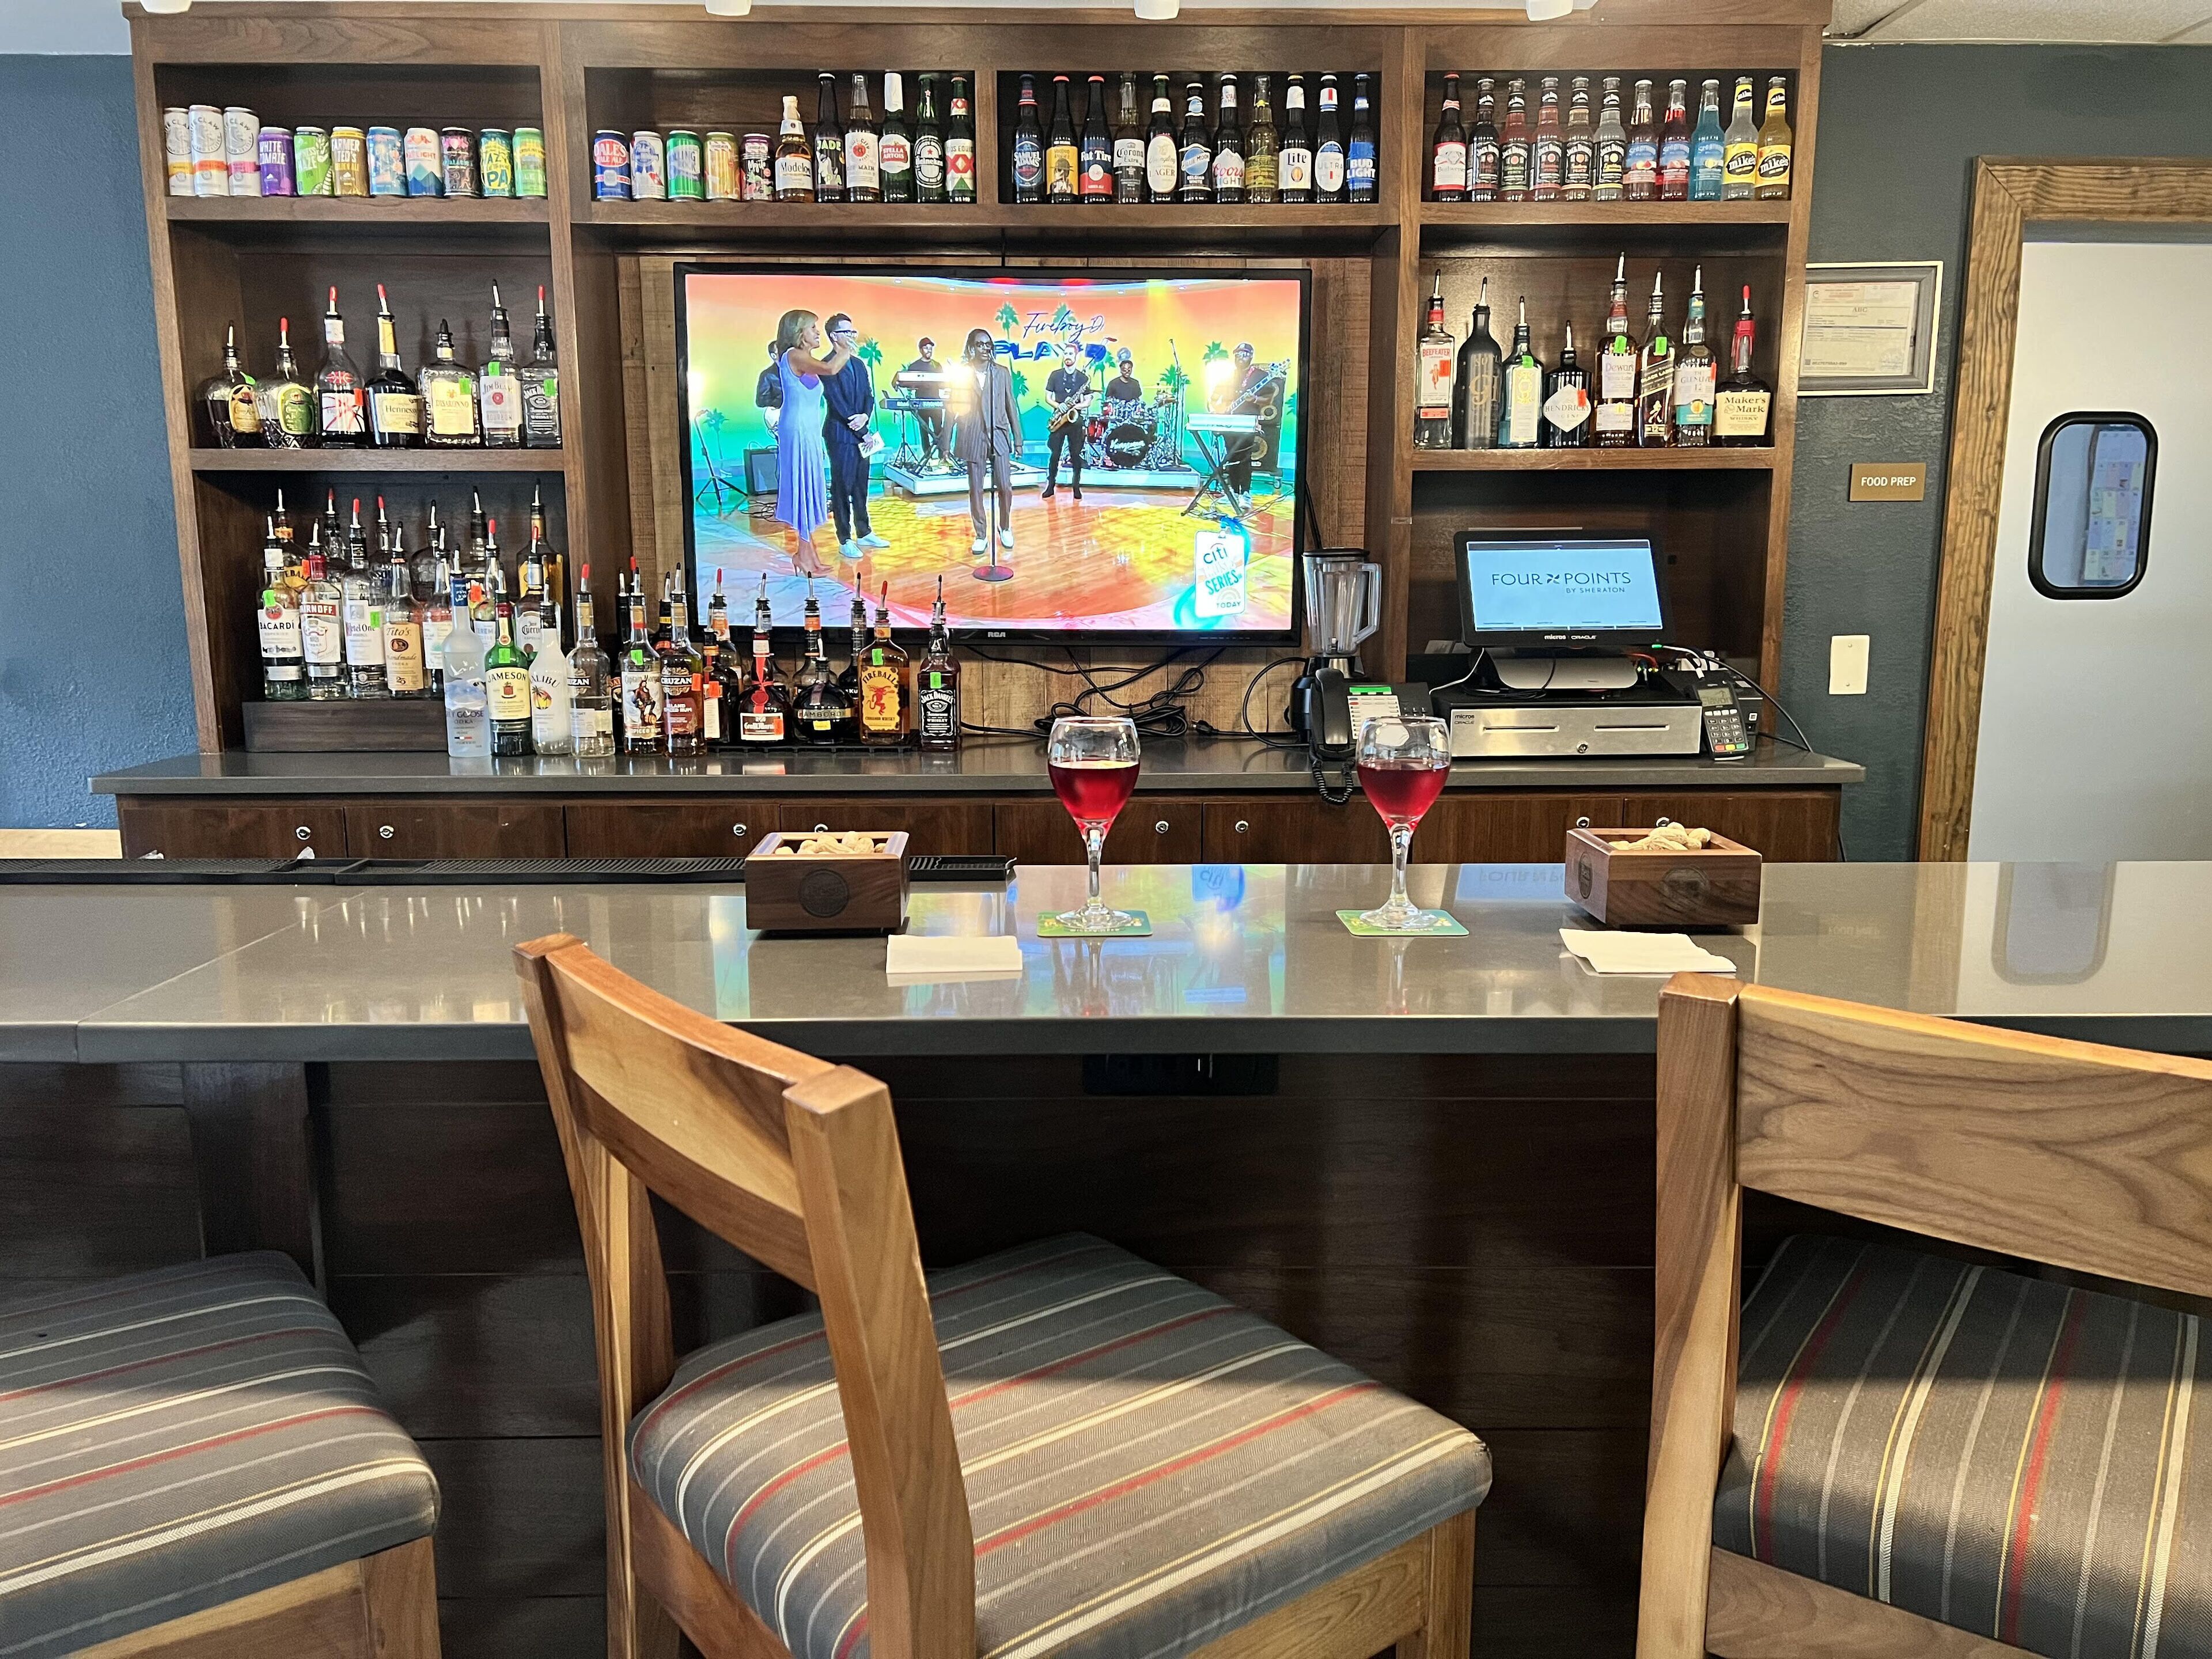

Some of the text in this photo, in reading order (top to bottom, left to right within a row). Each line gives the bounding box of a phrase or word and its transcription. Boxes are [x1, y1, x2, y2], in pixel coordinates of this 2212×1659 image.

[172, 119, 190, 129] CLA
[198, 117, 219, 130] CLAW
[230, 118, 251, 131] CLAW
[259, 141, 282, 153] WHITE
[332, 138, 359, 152] FARMER
[817, 140, 842, 151] JADE
[338, 151, 357, 162] TED'S
[1014, 151, 1041, 161] SAMUEL
[1081, 150, 1112, 162] Fat Tire
[1116, 148, 1143, 158] Corona
[915, 157, 943, 166] Heineken
[1016, 158, 1040, 168] ADAMS
[1287, 152, 1307, 166] Lite
[1350, 158, 1374, 169] BUD
[1729, 156, 1756, 171] mike's
[1760, 157, 1789, 172] mike's
[1212, 164, 1244, 177] Coors
[1317, 161, 1343, 170] ULTRA
[1346, 168, 1376, 179] LIGHT
[1422, 347, 1451, 357] BEEFEATER
[1605, 362, 1635, 372] Dewar's
[435, 399, 469, 408] DISARONNO
[486, 413, 513, 421] BOURBON
[1861, 476, 1916, 487] FOOD PREP
[1203, 546, 1228, 564] citi
[1205, 569, 1239, 595] SERIES
[1492, 572, 1631, 585] FOUR POINTS
[1216, 601, 1241, 609] TODAY
[259, 619, 294, 630] BACARDÍ
[387, 627, 411, 637] Tito's
[487, 672, 527, 683] JAMESON
[862, 669, 898, 685] FIREBALL
[921, 691, 954, 704] JACK DANIEL'S
[457, 710, 484, 718] GOOSE
